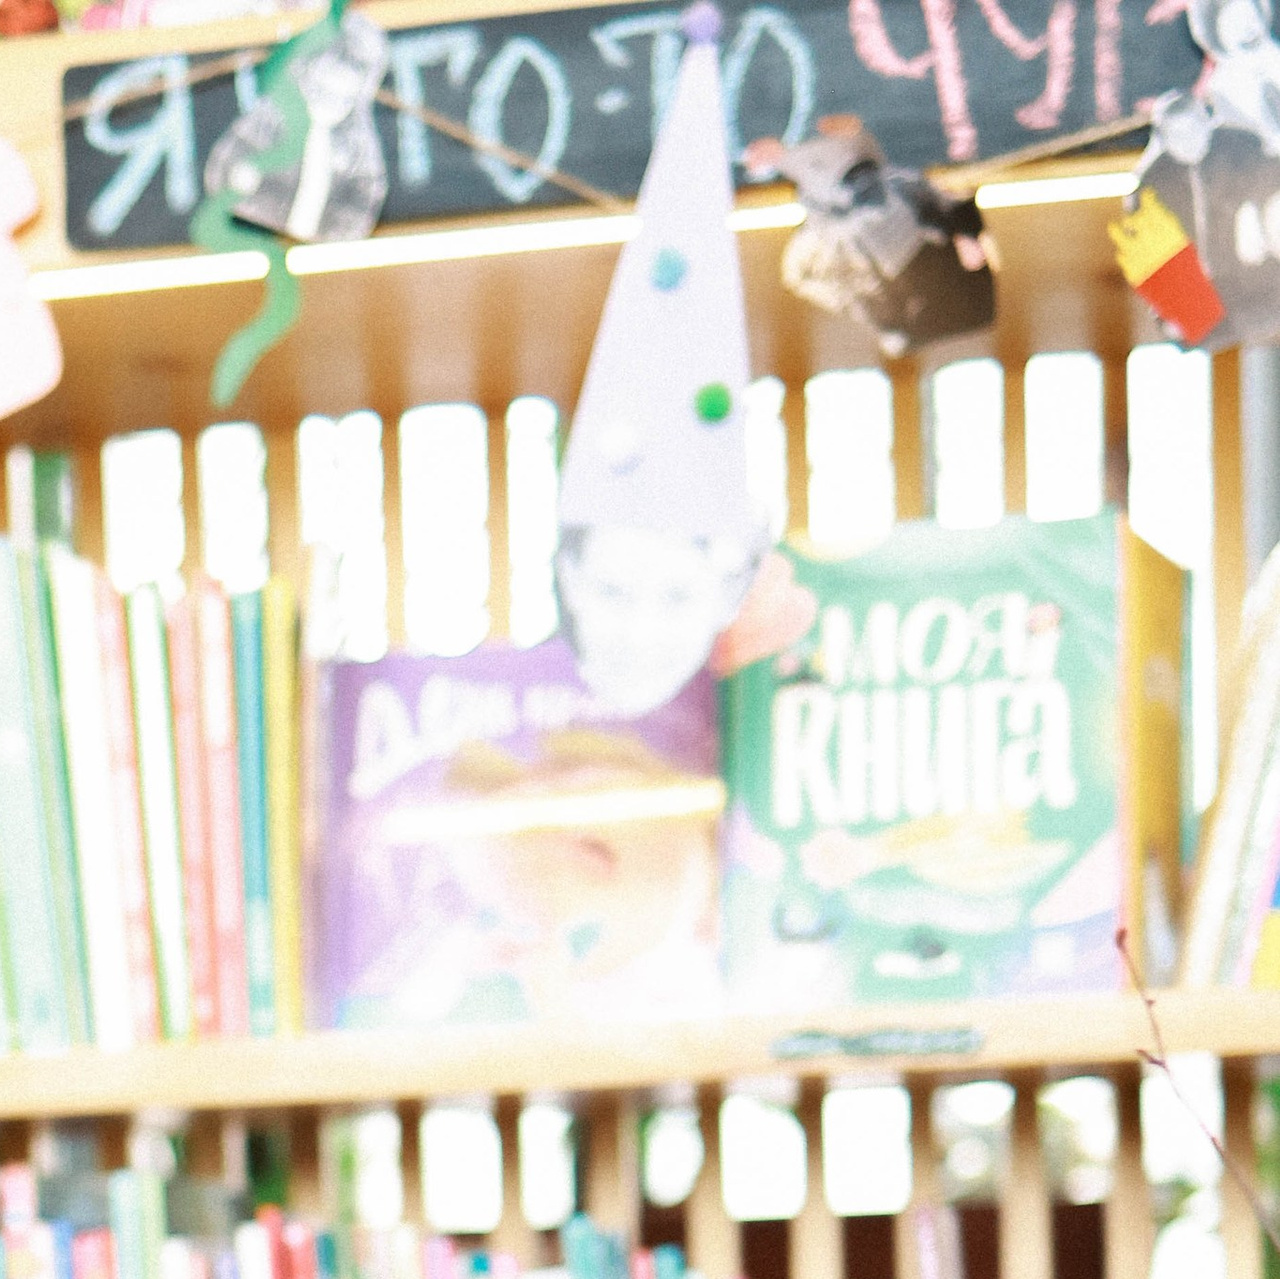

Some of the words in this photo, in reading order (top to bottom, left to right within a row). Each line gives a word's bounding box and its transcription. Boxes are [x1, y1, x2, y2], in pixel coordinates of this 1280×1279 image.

[84, 53, 200, 238] Я
[233, 8, 818, 206] ТО-ТО
[821, 592, 1029, 686] МОЯ
